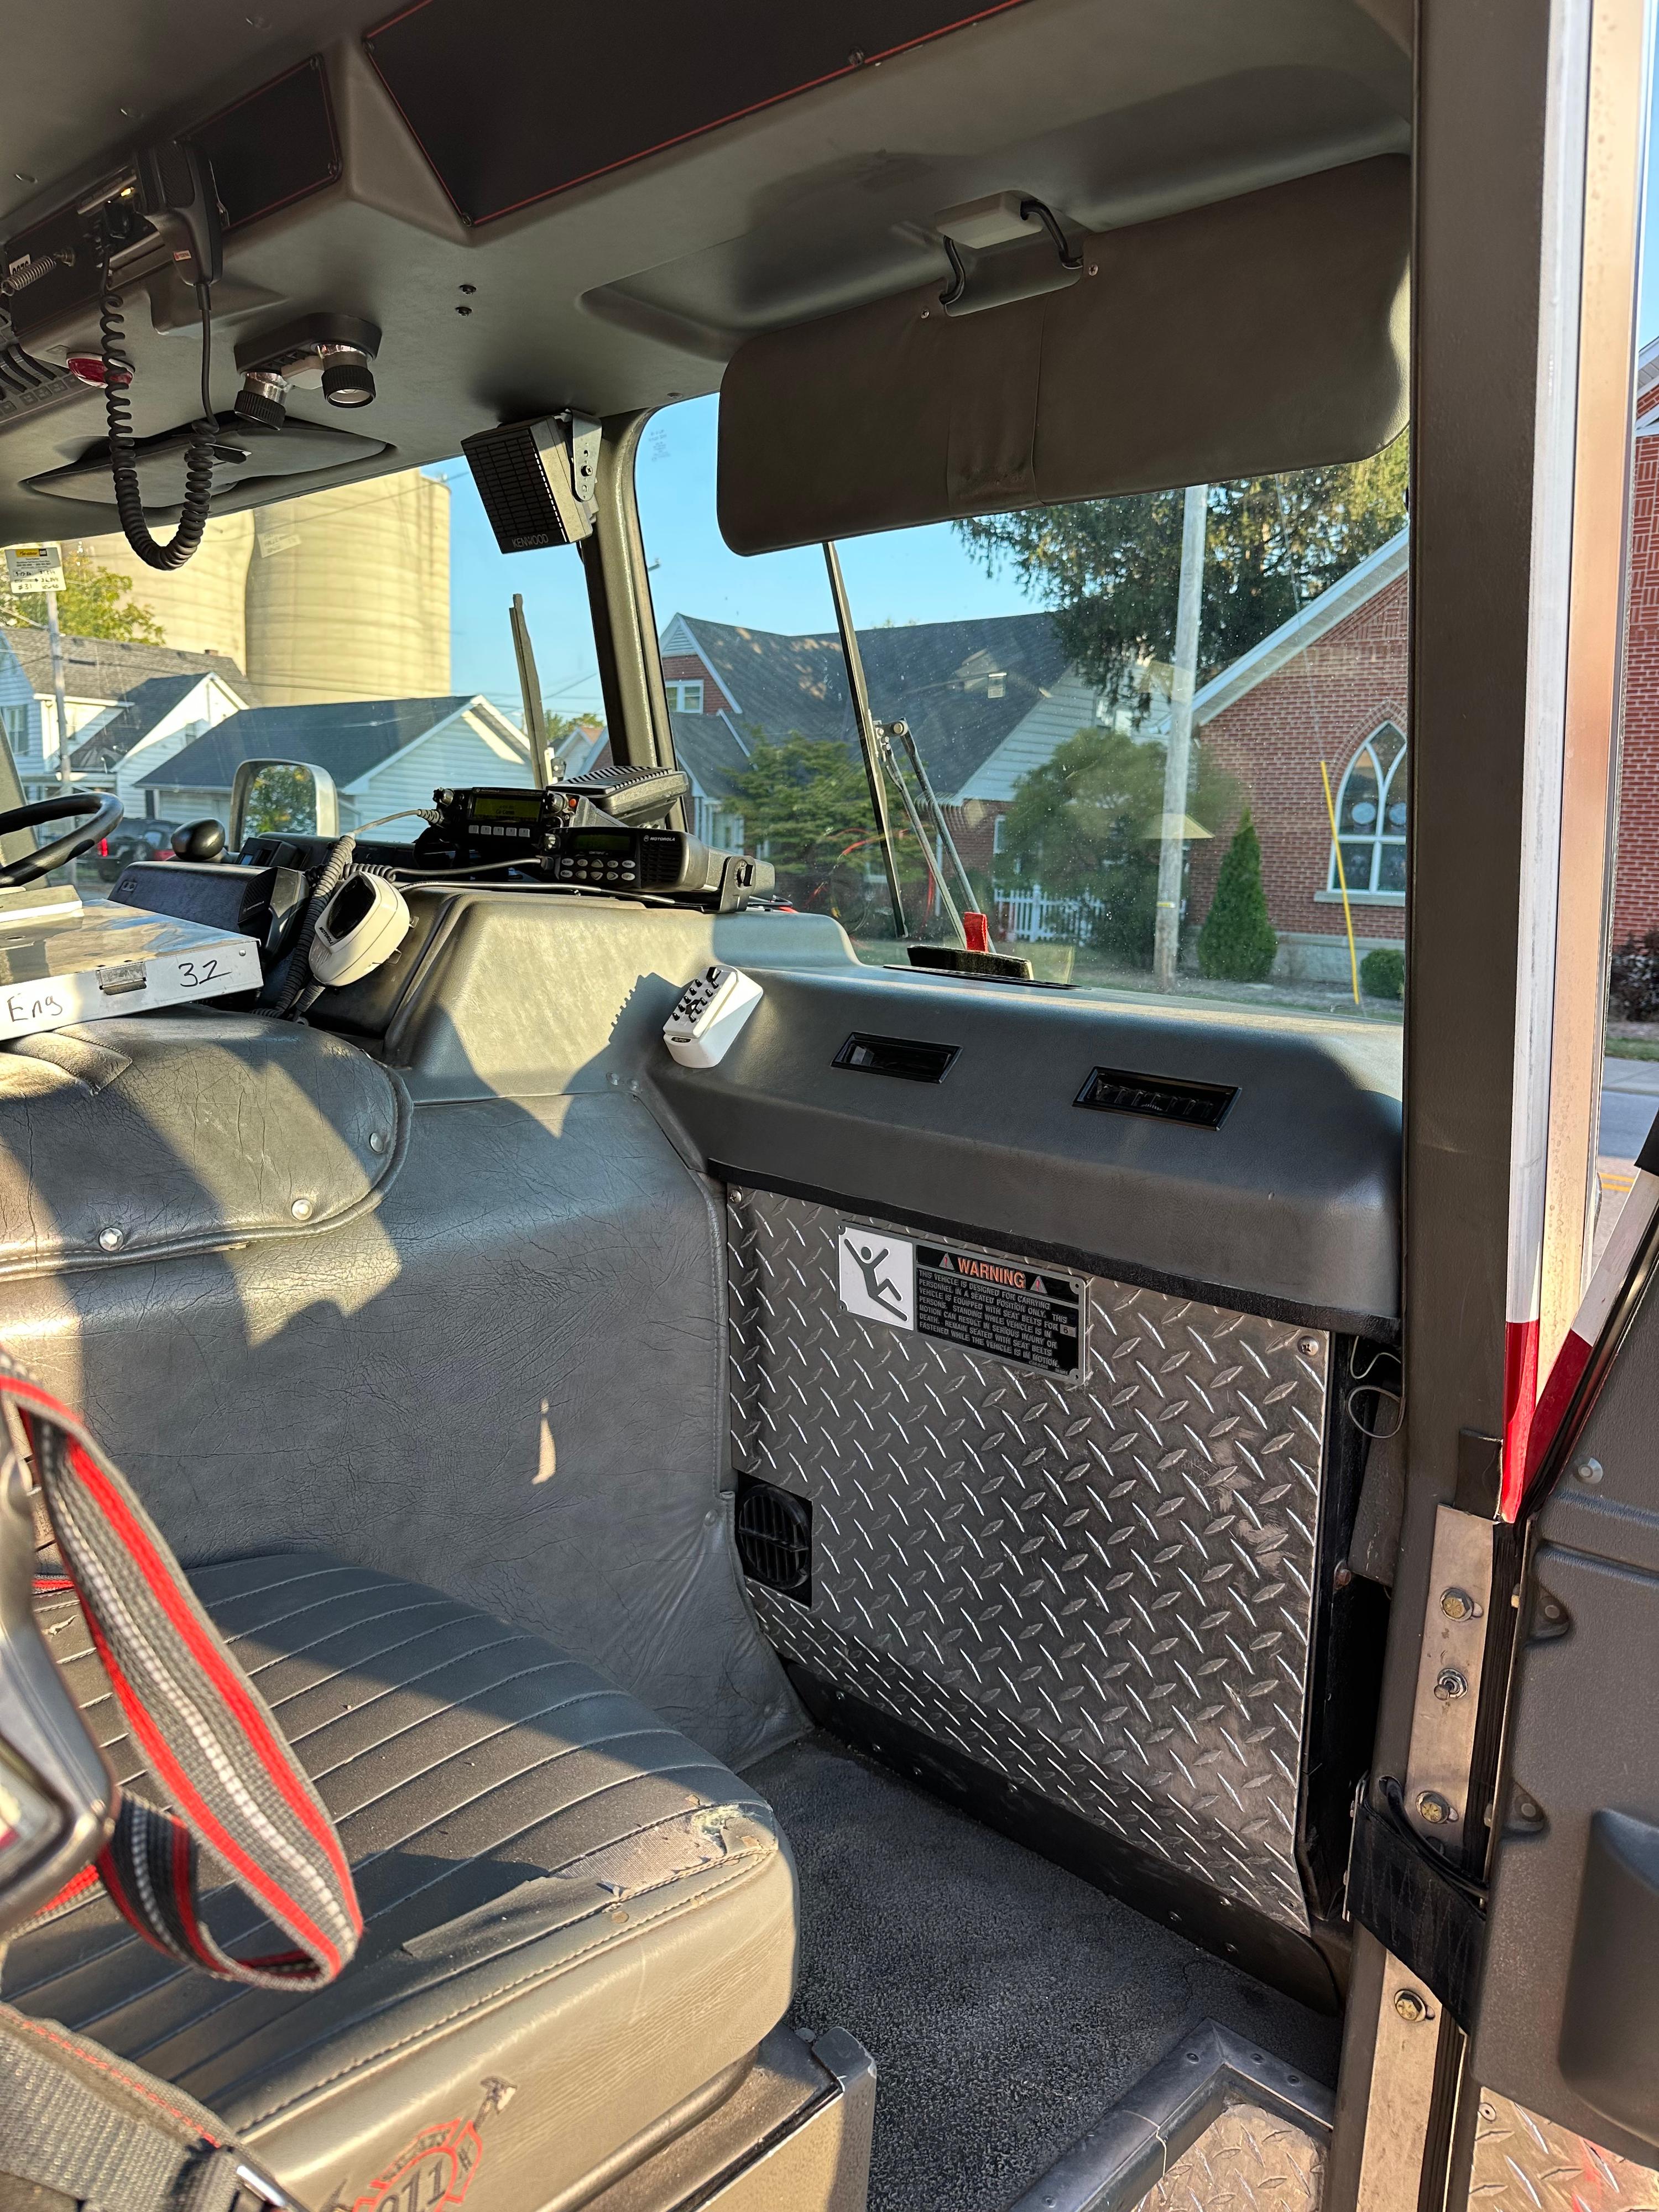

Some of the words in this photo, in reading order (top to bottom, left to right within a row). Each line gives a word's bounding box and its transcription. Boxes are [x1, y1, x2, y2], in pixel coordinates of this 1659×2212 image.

[512, 534, 549, 547] KENWOOD
[319, 926, 333, 945] MOTOROLA
[7, 995, 64, 1022] Eng
[919, 1270, 932, 1279] THIS
[934, 1273, 959, 1286] VEHICLE
[961, 1280, 967, 1288] IS
[969, 1282, 1000, 1297] DESIGNED
[1001, 1291, 1016, 1301] FOR
[1017, 1295, 1051, 1311] CARRYING
[957, 1257, 1026, 1289] WARNING
[919, 1279, 953, 1293] PERSONNEL
[955, 1287, 962, 1295] IN
[971, 1292, 995, 1304] SEATED
[997, 1298, 1026, 1313] POSITION
[1052, 1313, 1068, 1324] THIS
[919, 1287, 943, 1299] VEHICLE
[945, 1293, 952, 1302] IS
[953, 1296, 983, 1310] EQUIPPED
[985, 1305, 1001, 1315] WITH
[1003, 1309, 1020, 1321] SEAT
[1021, 1315, 1042, 1326] BELTS
[1044, 1321, 1059, 1331] FOR
[919, 1304, 941, 1316] MOTION
[943, 1311, 957, 1321] CAN
[958, 1315, 982, 1327] RESULT
[983, 1322, 990, 1330] IN
[992, 1324, 1020, 1338] SERIOUS
[1021, 1333, 1045, 1345] INJURY
[1047, 1340, 1058, 1349] OR
[920, 1321, 949, 1335] FASTENED
[951, 1330, 970, 1342] WHILE
[972, 1336, 984, 1346] THE
[986, 1340, 1013, 1354] VEHICLE
[1014, 1348, 1021, 1357] IS
[1023, 1350, 1031, 1359] IN
[945, 1320, 968, 1332] REMAIN
[969, 1327, 993, 1339] SEATED
[995, 1334, 1011, 1345] WITH
[1013, 1339, 1030, 1350] SEAT
[1031, 1344, 1052, 1357] BELTS
[953, 1305, 983, 1319] STANDING
[984, 1313, 1005, 1325] WHILE
[1006, 1319, 1034, 1333] VEHICLE
[1035, 1327, 1042, 1335] IS
[1044, 1330, 1052, 1339] IN
